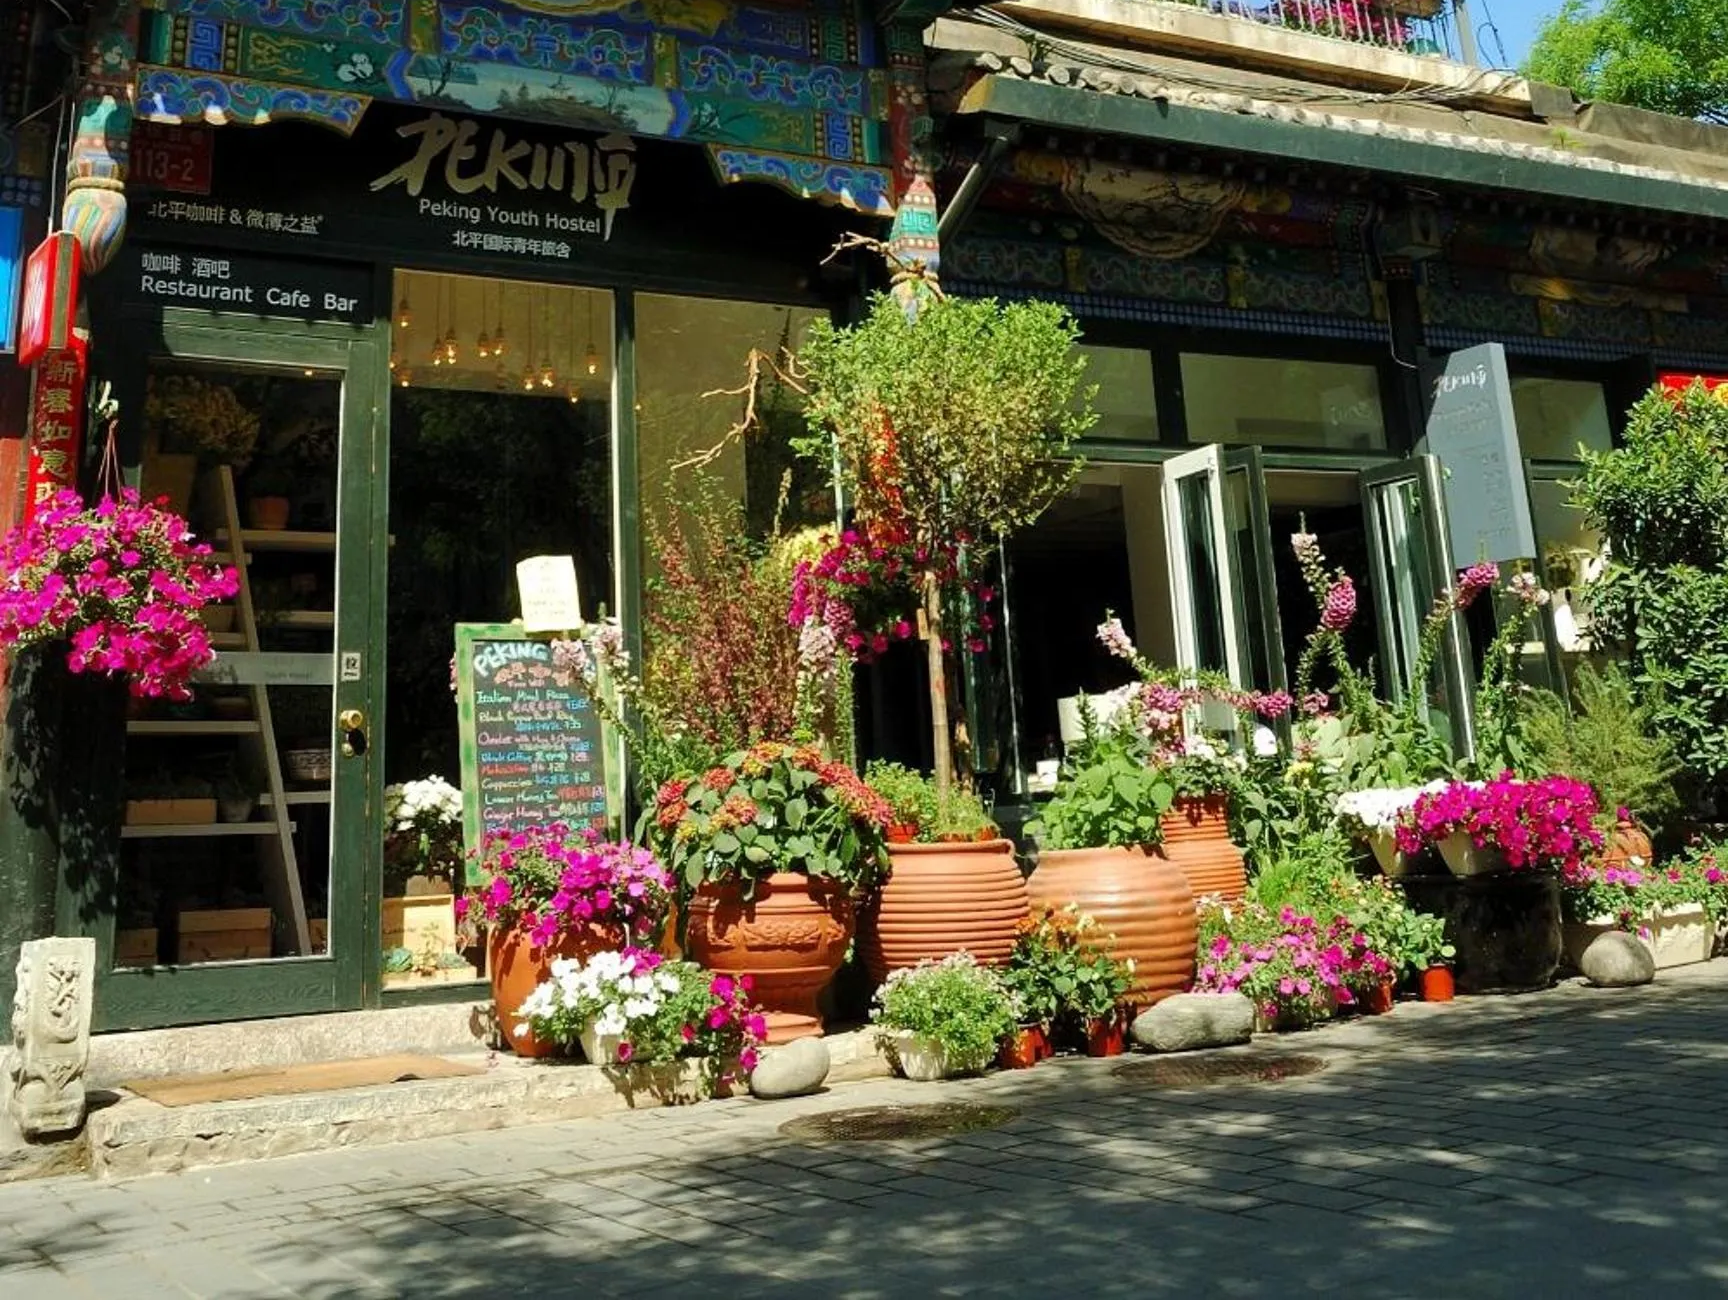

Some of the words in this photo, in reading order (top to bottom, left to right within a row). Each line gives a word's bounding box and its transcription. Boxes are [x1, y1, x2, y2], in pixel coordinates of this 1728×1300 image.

[134, 148, 195, 182] 113-2
[147, 201, 227, 225] 北平咖啡
[229, 208, 244, 226] &
[419, 198, 481, 224] Peking
[487, 206, 540, 228] Youth
[545, 212, 601, 234] Hostel
[141, 252, 182, 275] 咖啡
[191, 257, 231, 280] 酒吧
[141, 275, 254, 304] Restaurant
[265, 287, 311, 308] Cafe
[323, 292, 358, 313] Bar
[474, 642, 549, 677] PEKING
